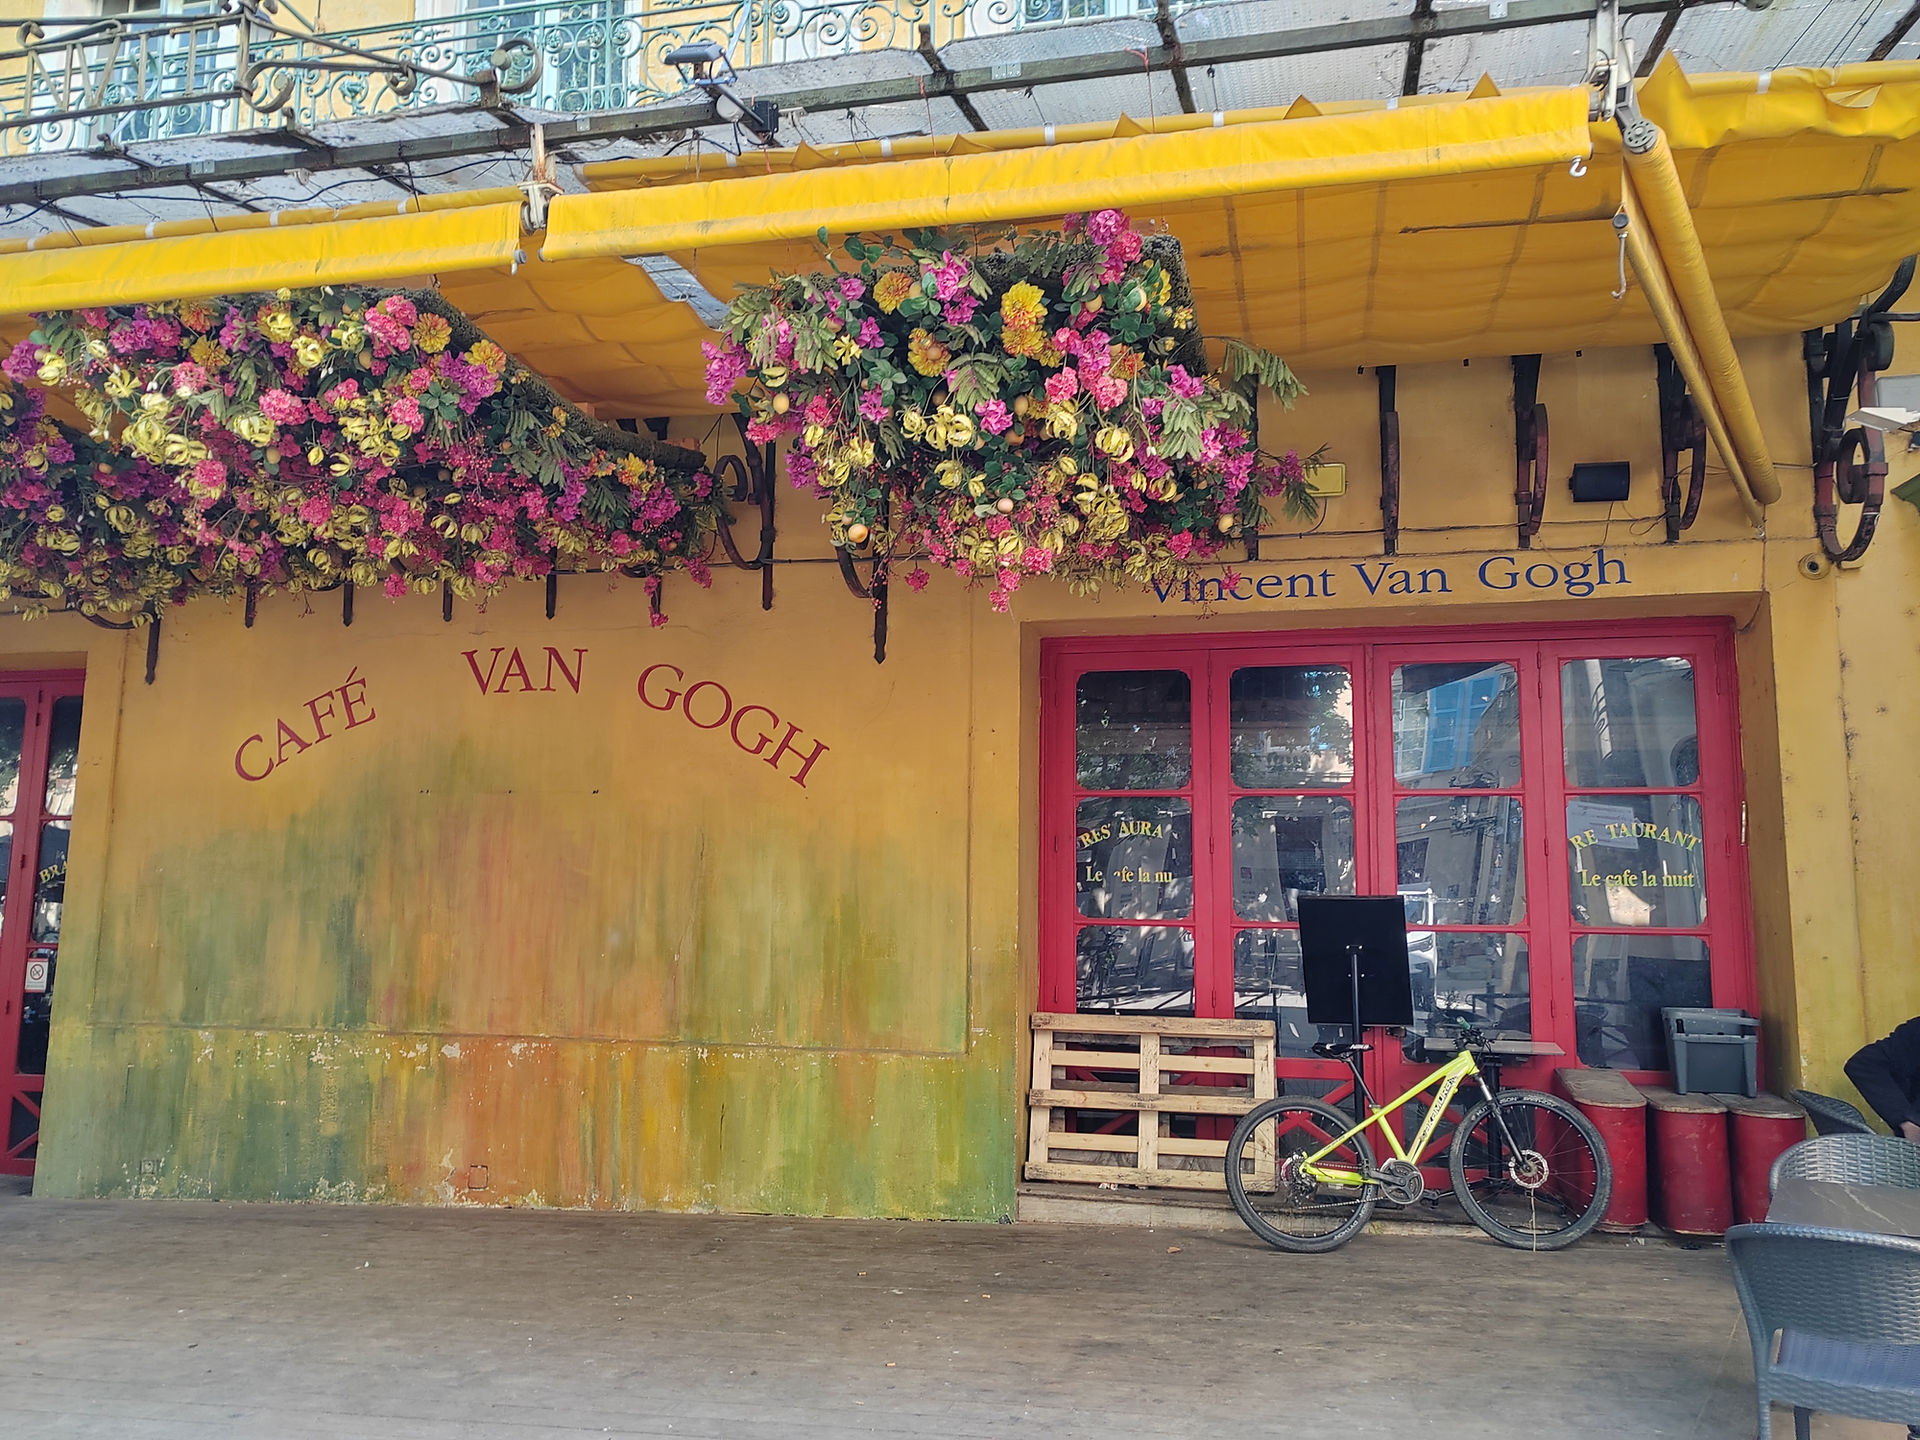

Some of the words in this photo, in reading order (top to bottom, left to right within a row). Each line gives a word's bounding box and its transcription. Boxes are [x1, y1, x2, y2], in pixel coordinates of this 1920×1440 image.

[1151, 567, 1336, 603] Vincent
[1352, 562, 1452, 597] Van
[1477, 549, 1632, 597] Gogh
[234, 666, 377, 782] CAFÉ
[461, 647, 589, 696] VAN
[637, 663, 830, 788] GOGH
[1569, 822, 1702, 851] RETAURANT
[1085, 866, 1103, 882] Le
[1138, 867, 1150, 882] la
[1581, 869, 1601, 887] Le
[1642, 870, 1657, 887] la
[1662, 870, 1695, 887] nuit
